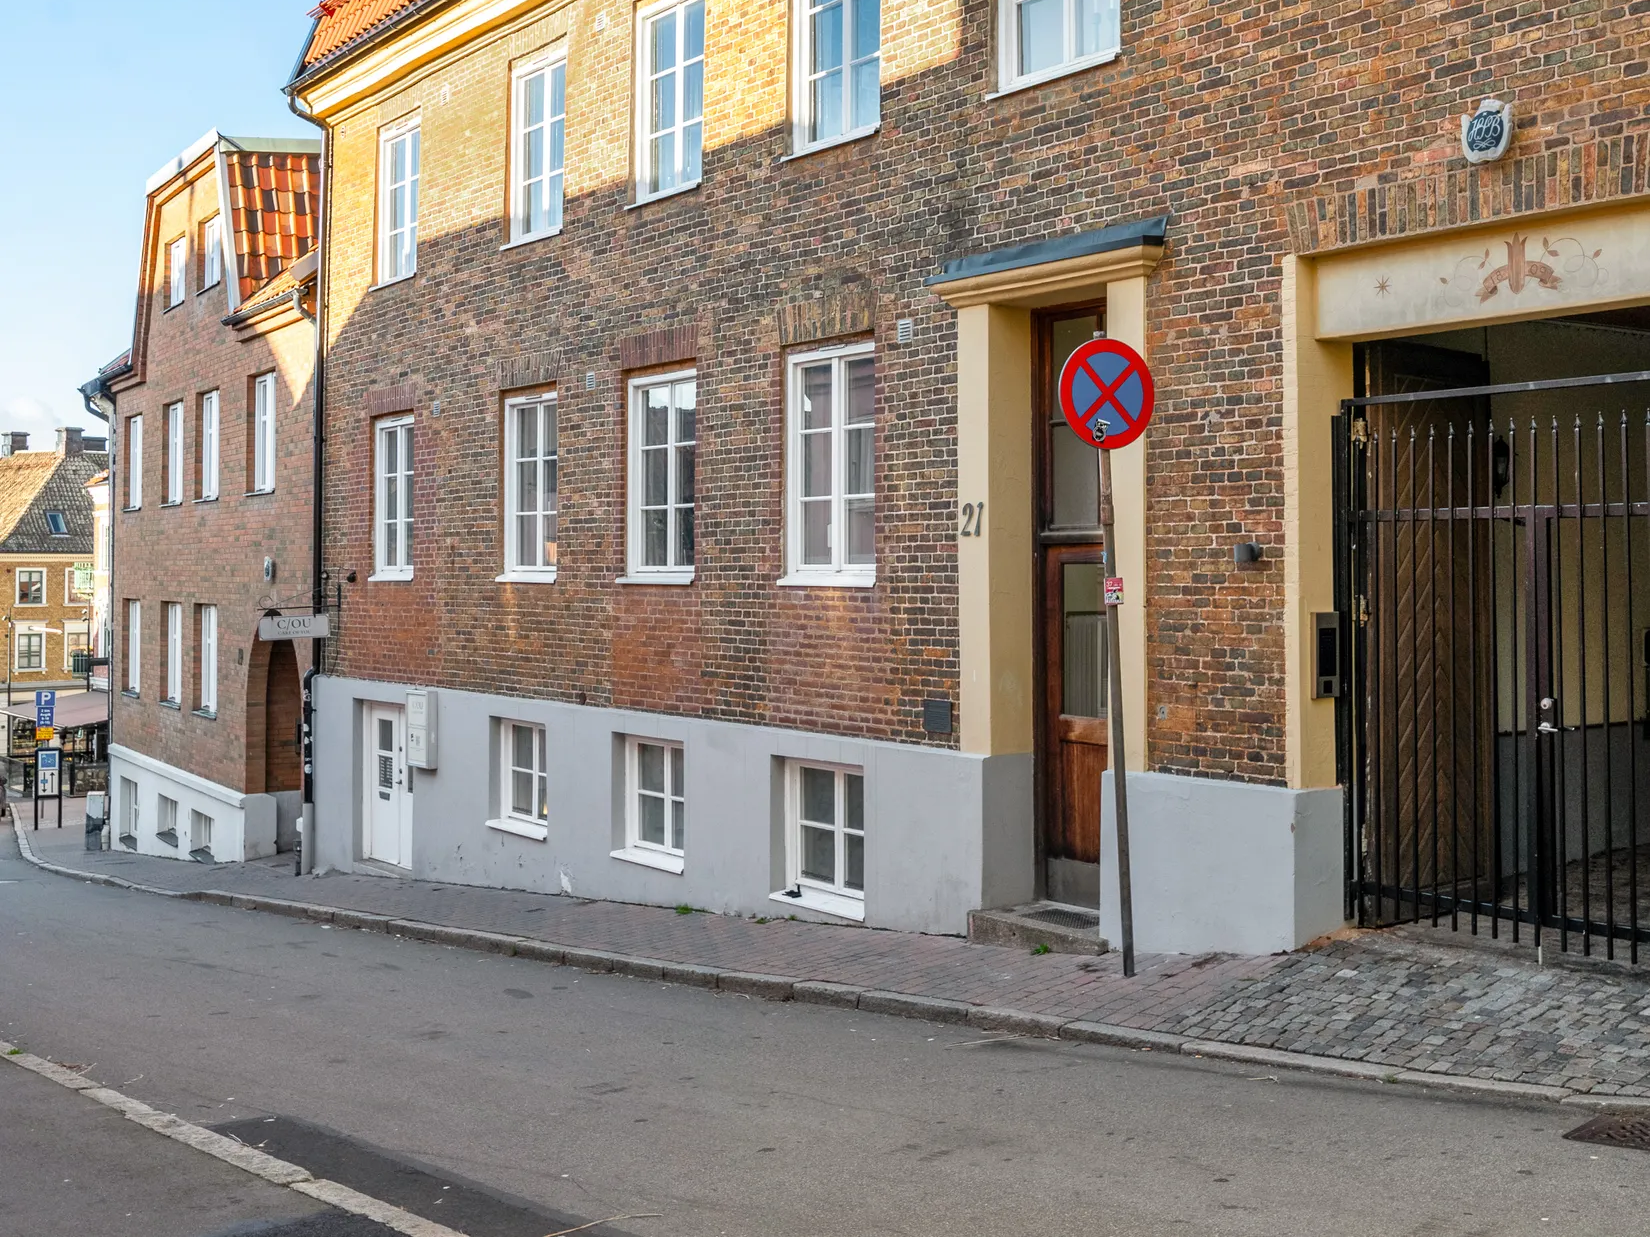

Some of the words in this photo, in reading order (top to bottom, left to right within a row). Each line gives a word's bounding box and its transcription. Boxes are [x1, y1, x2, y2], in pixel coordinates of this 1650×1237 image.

[960, 501, 984, 537] 21
[277, 618, 311, 630] C/OU
[41, 692, 51, 705] P
